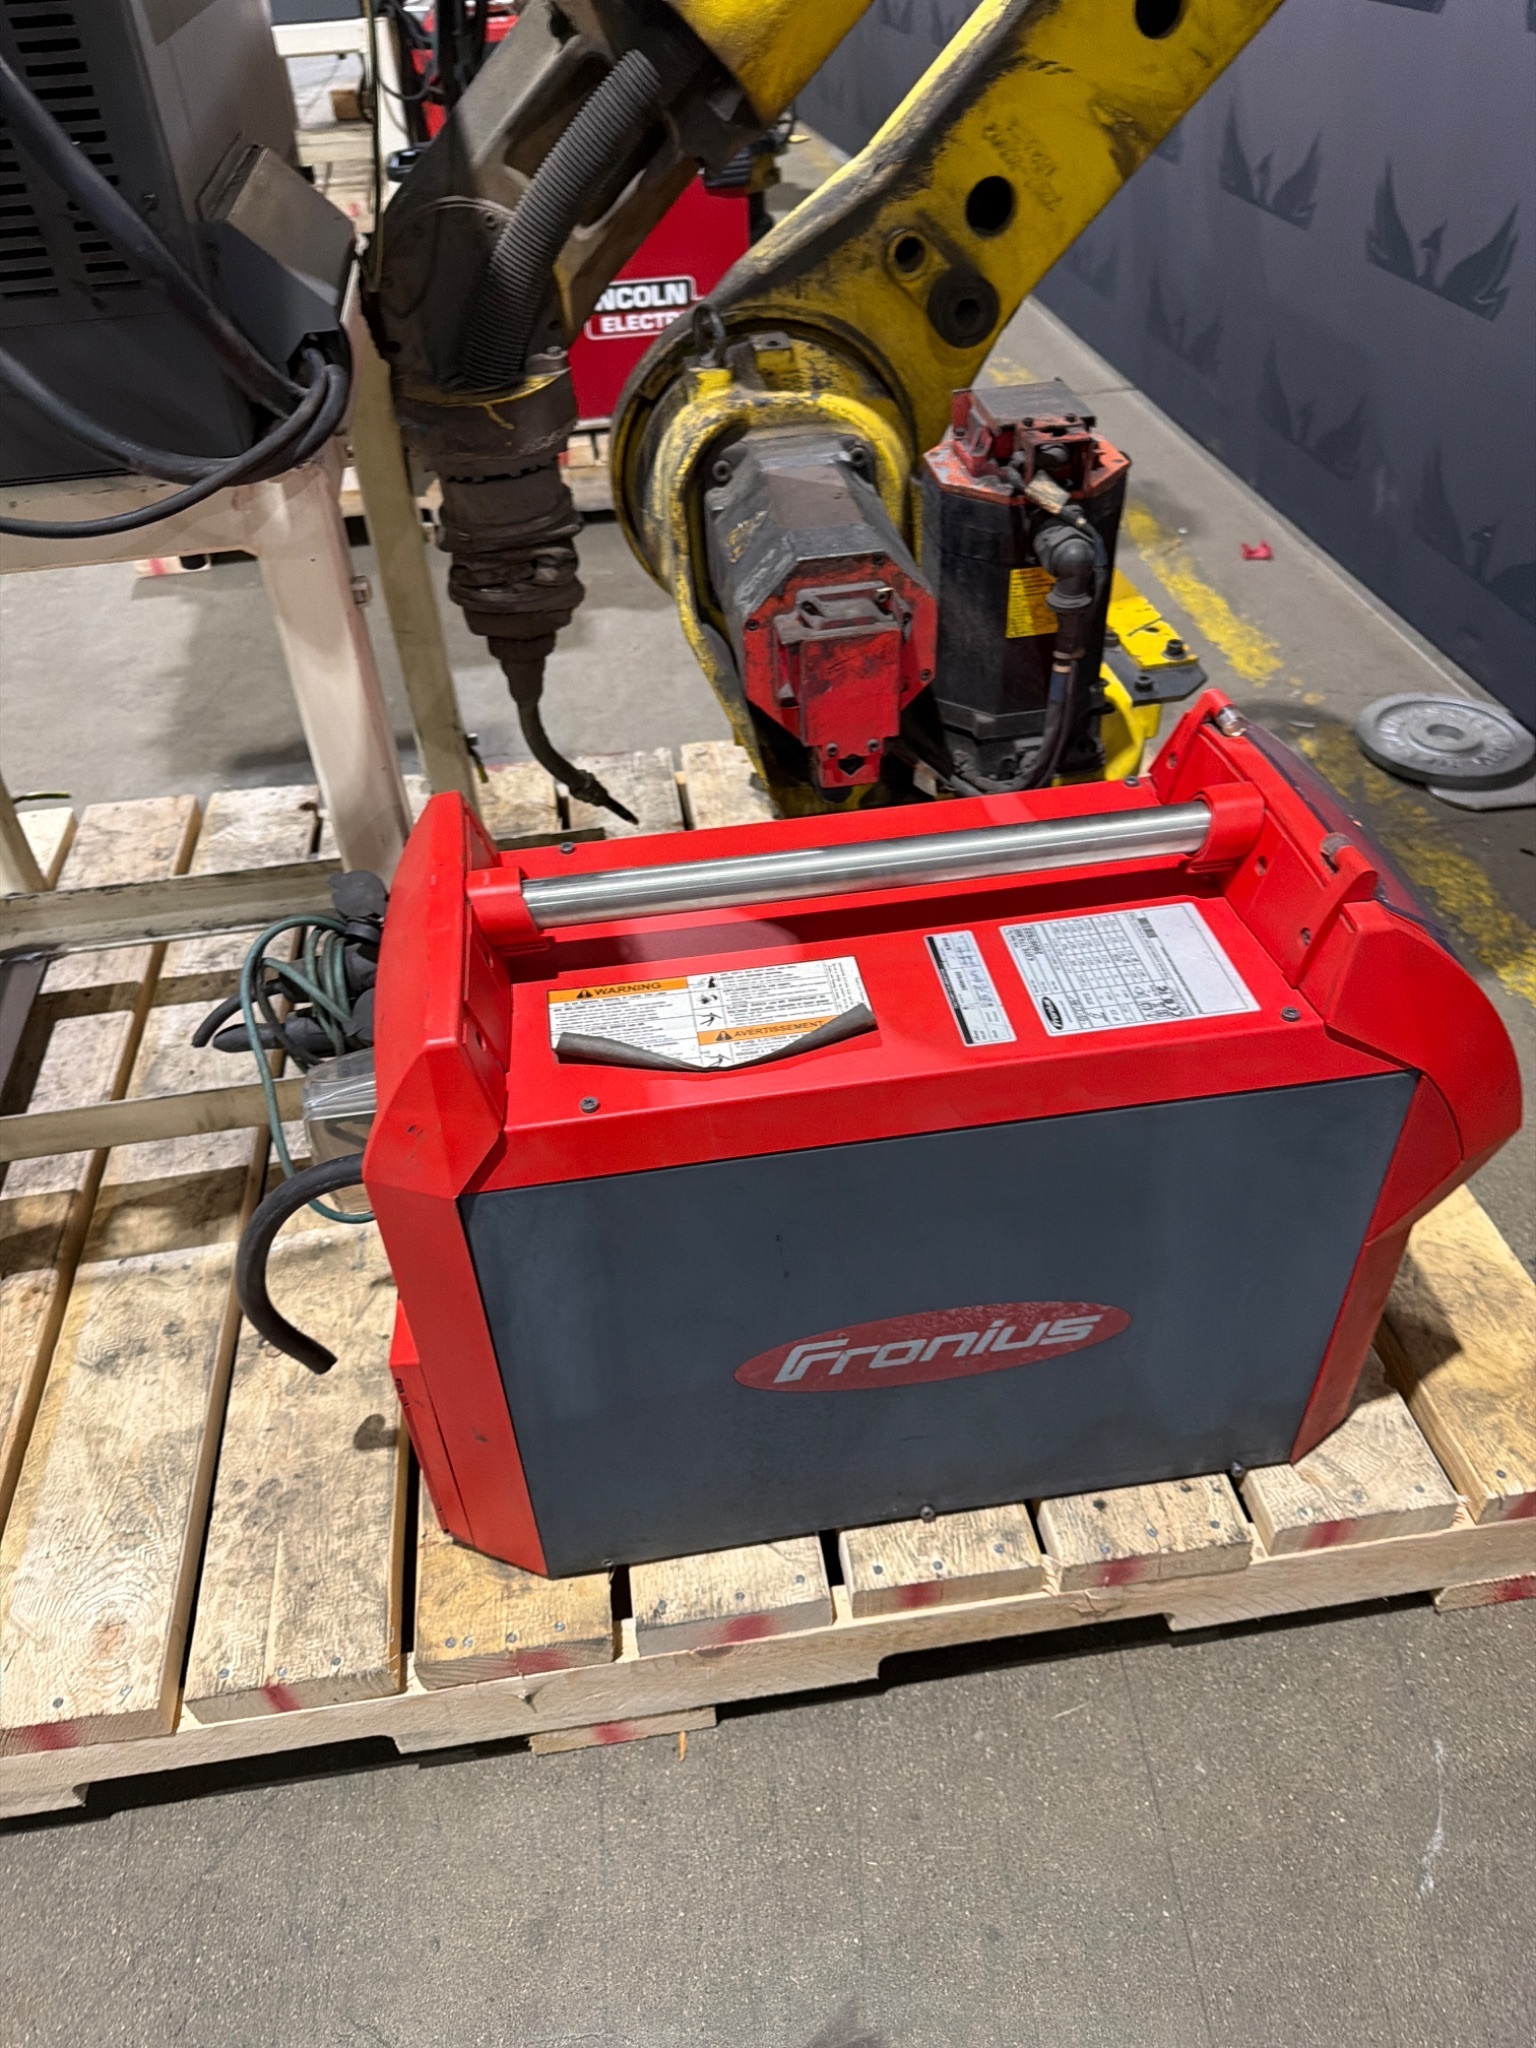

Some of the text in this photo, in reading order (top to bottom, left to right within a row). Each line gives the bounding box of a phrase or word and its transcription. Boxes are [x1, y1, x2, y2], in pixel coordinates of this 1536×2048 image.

[594, 282, 688, 312] NCOLN
[593, 981, 663, 997] WARNING
[733, 1020, 824, 1038] AVERTISSEMENT
[773, 1315, 1103, 1384] Fronius
